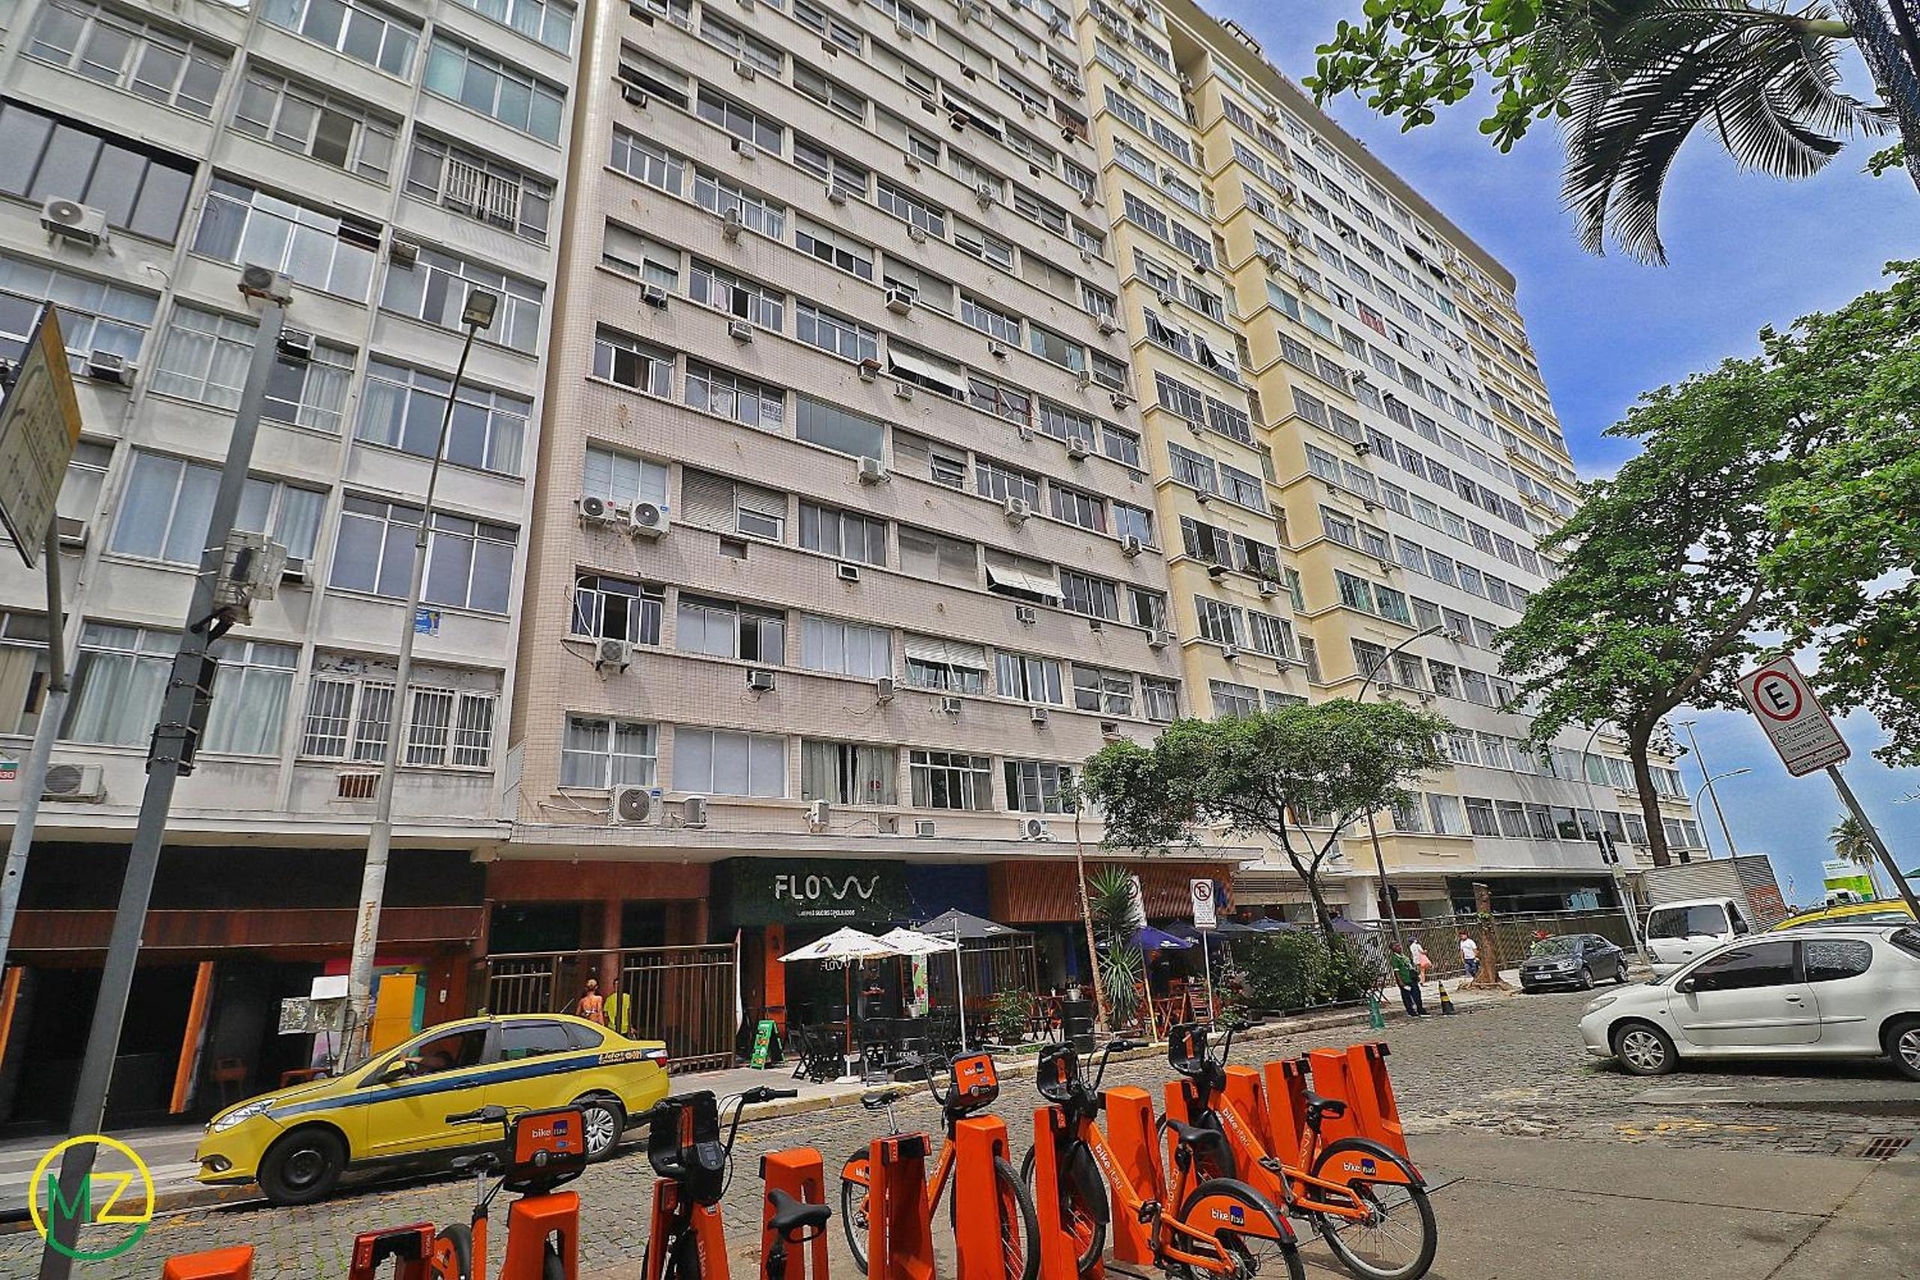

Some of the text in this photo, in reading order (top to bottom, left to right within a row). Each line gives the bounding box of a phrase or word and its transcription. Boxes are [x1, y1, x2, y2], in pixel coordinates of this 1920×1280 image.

[1764, 681, 1791, 711] E
[775, 875, 880, 900] FLOW
[1223, 1107, 1239, 1130] bike
[531, 1126, 552, 1139] bike
[1095, 1142, 1111, 1169] bike
[1343, 1161, 1361, 1172] bike
[1210, 1207, 1230, 1221] bike
